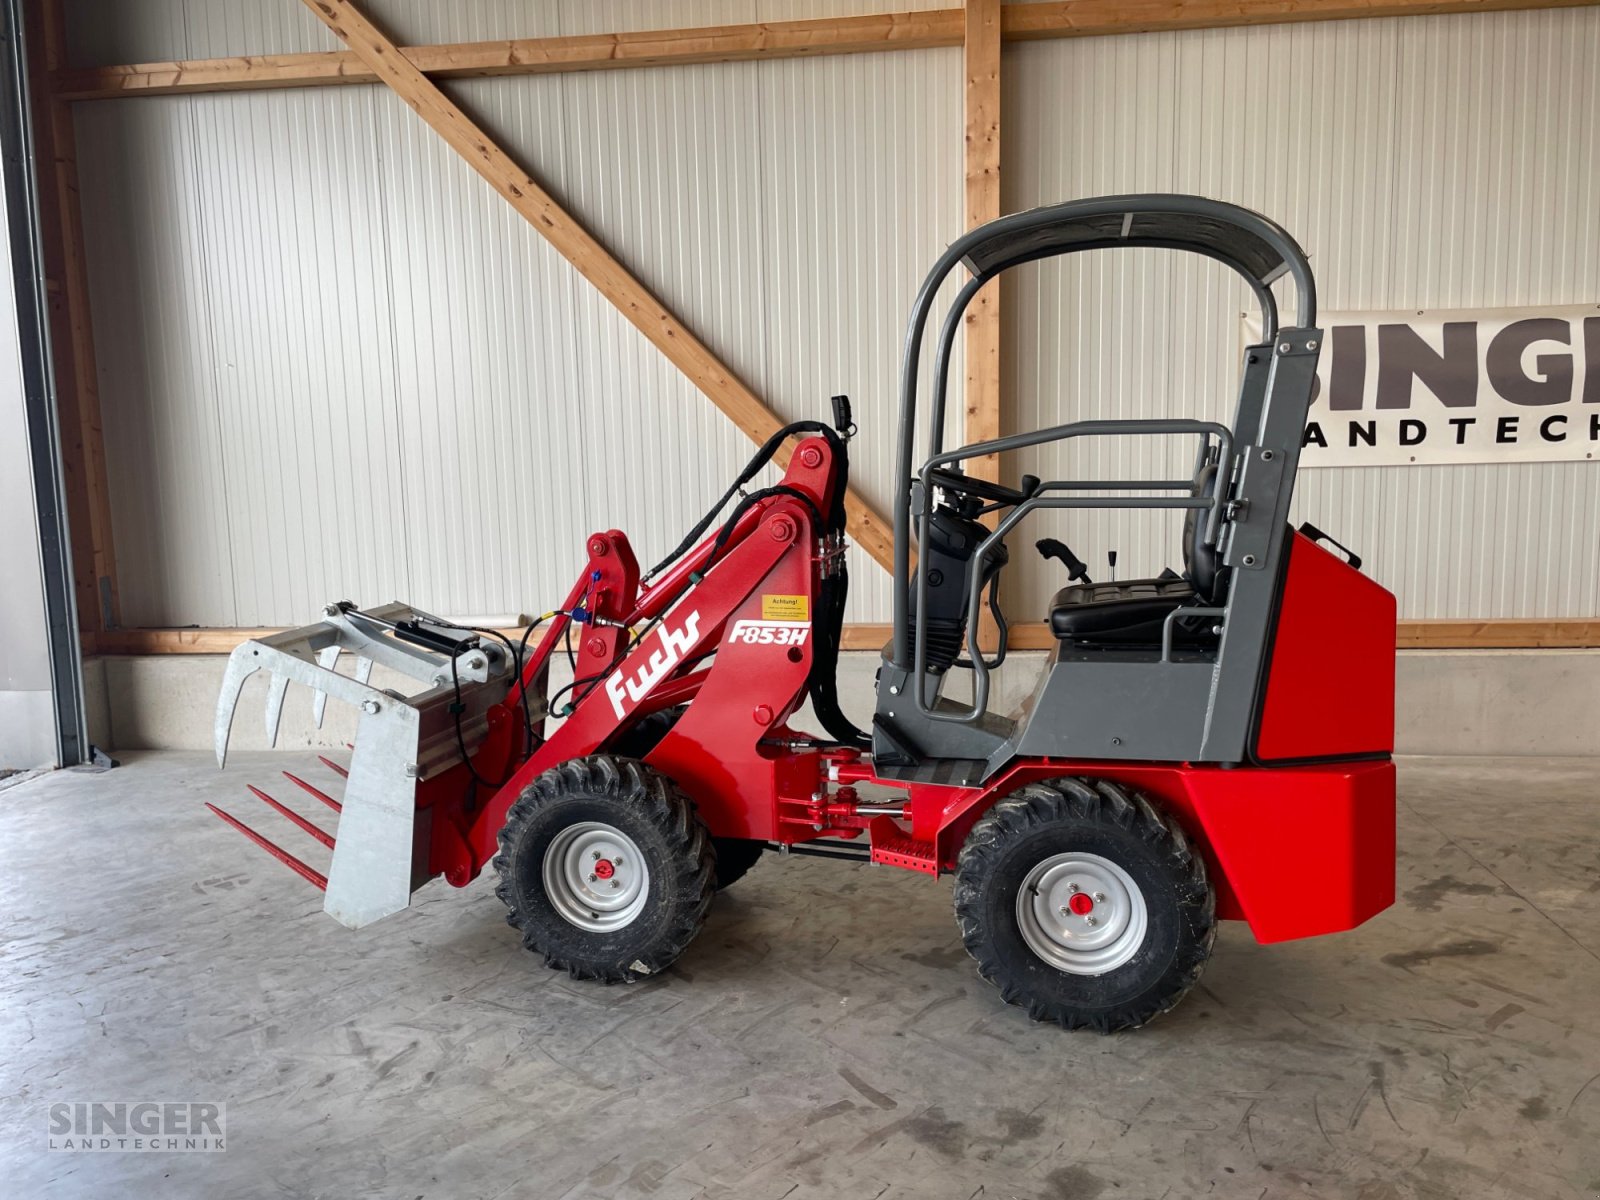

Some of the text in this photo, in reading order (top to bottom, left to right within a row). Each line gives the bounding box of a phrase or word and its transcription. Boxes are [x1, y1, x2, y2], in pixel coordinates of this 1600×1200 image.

[1280, 317, 1600, 411] ING
[605, 609, 699, 721] Fuchs
[728, 619, 812, 645] F853H
